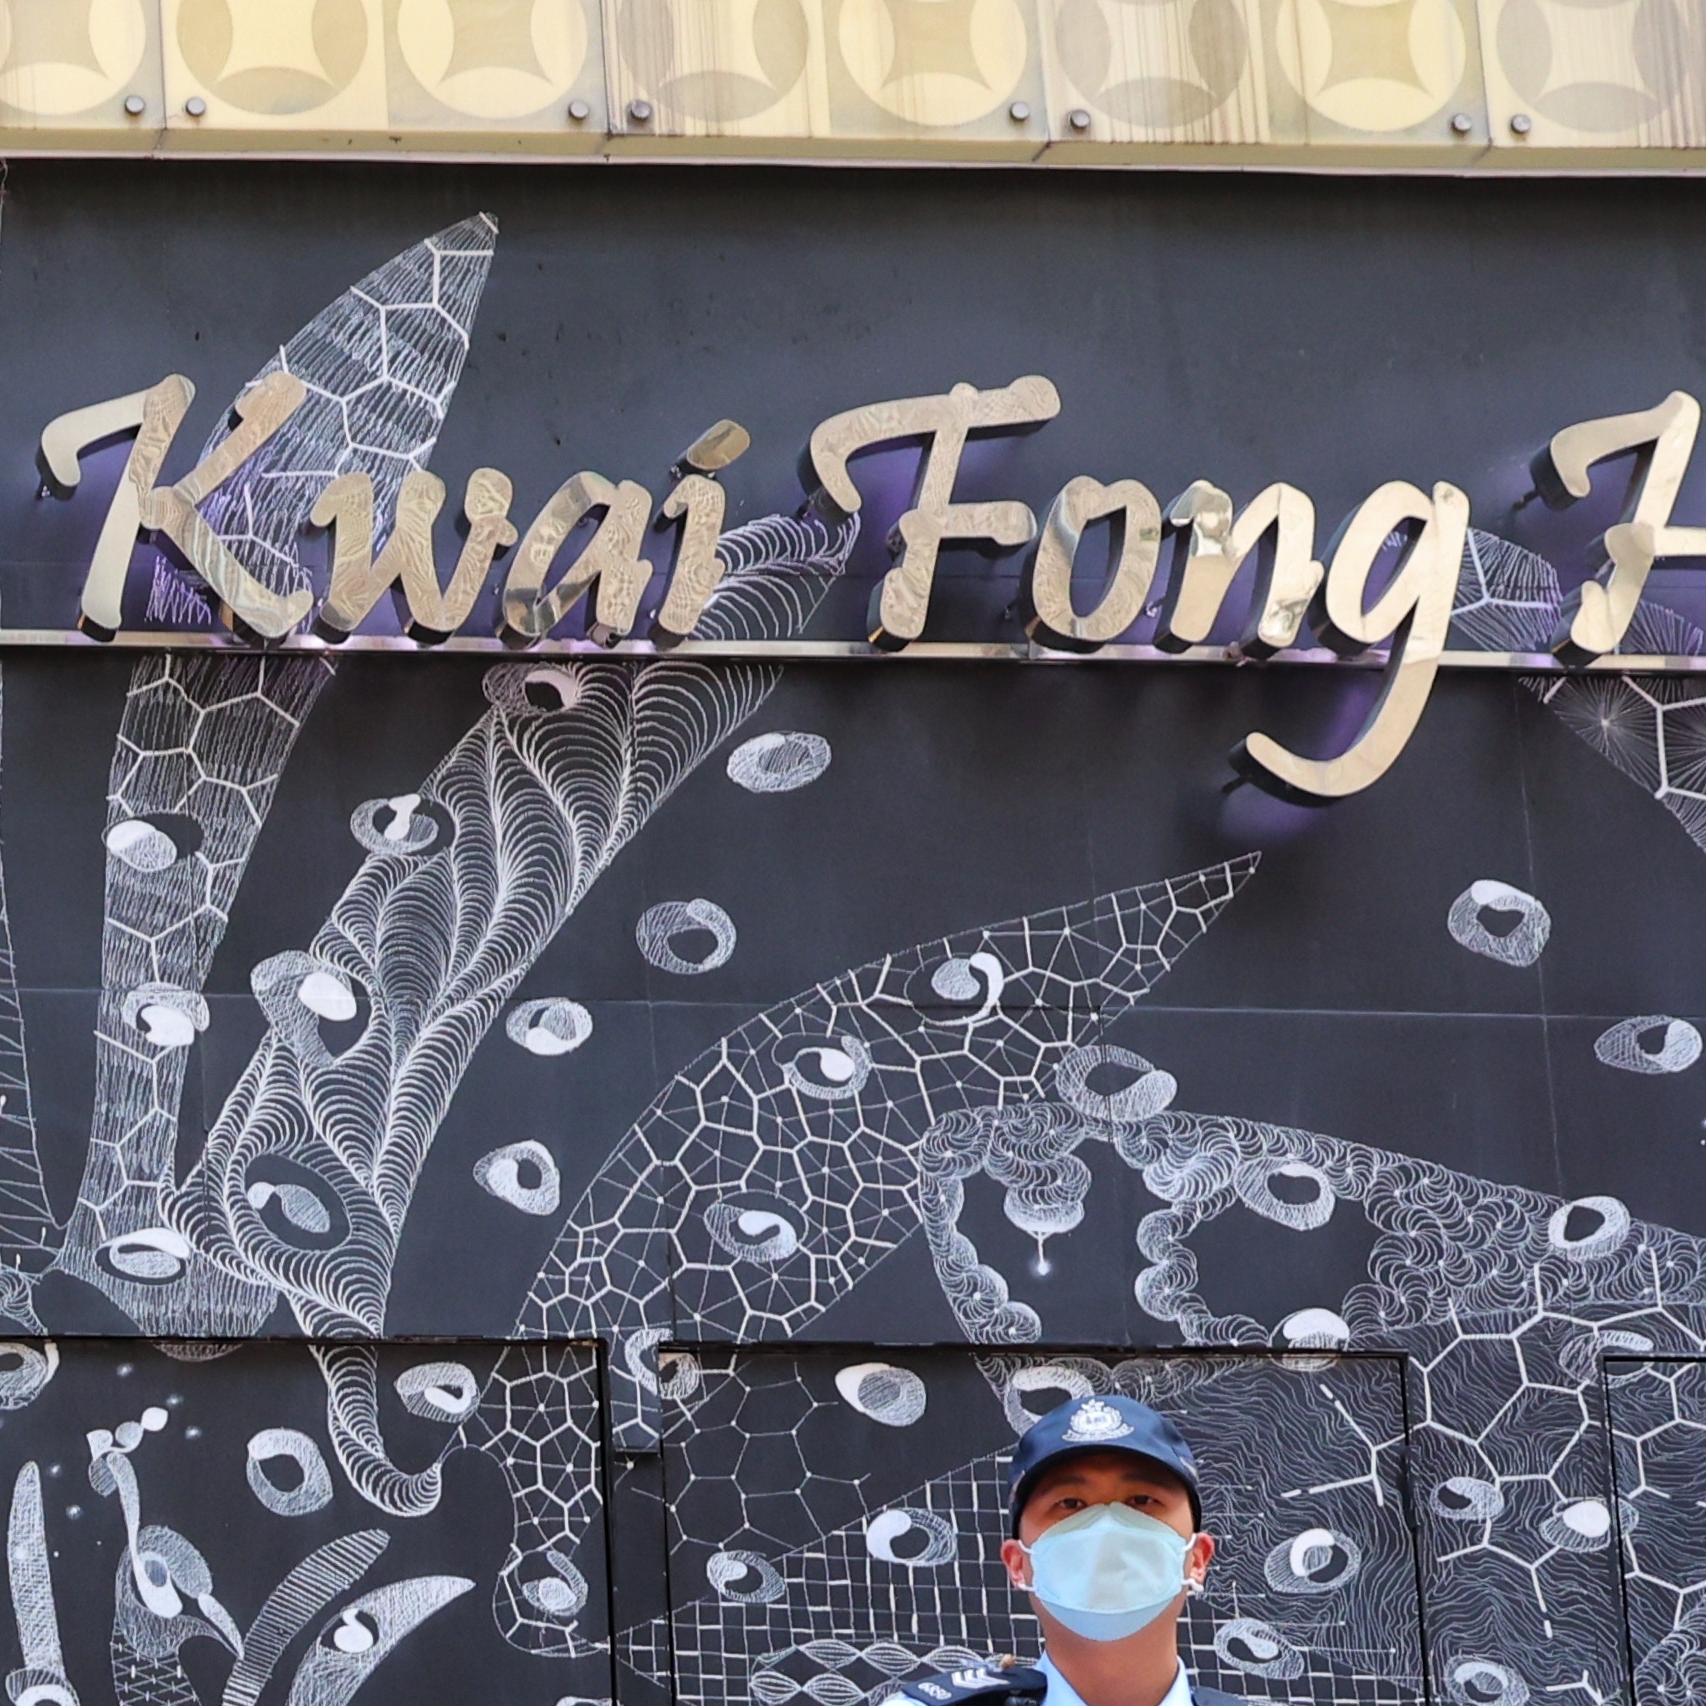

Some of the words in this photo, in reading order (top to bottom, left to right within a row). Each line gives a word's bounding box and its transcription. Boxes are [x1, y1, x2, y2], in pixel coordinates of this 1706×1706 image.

[41, 373, 751, 640] Kwai
[808, 373, 1470, 796] Fong
[1548, 390, 1706, 655] H
